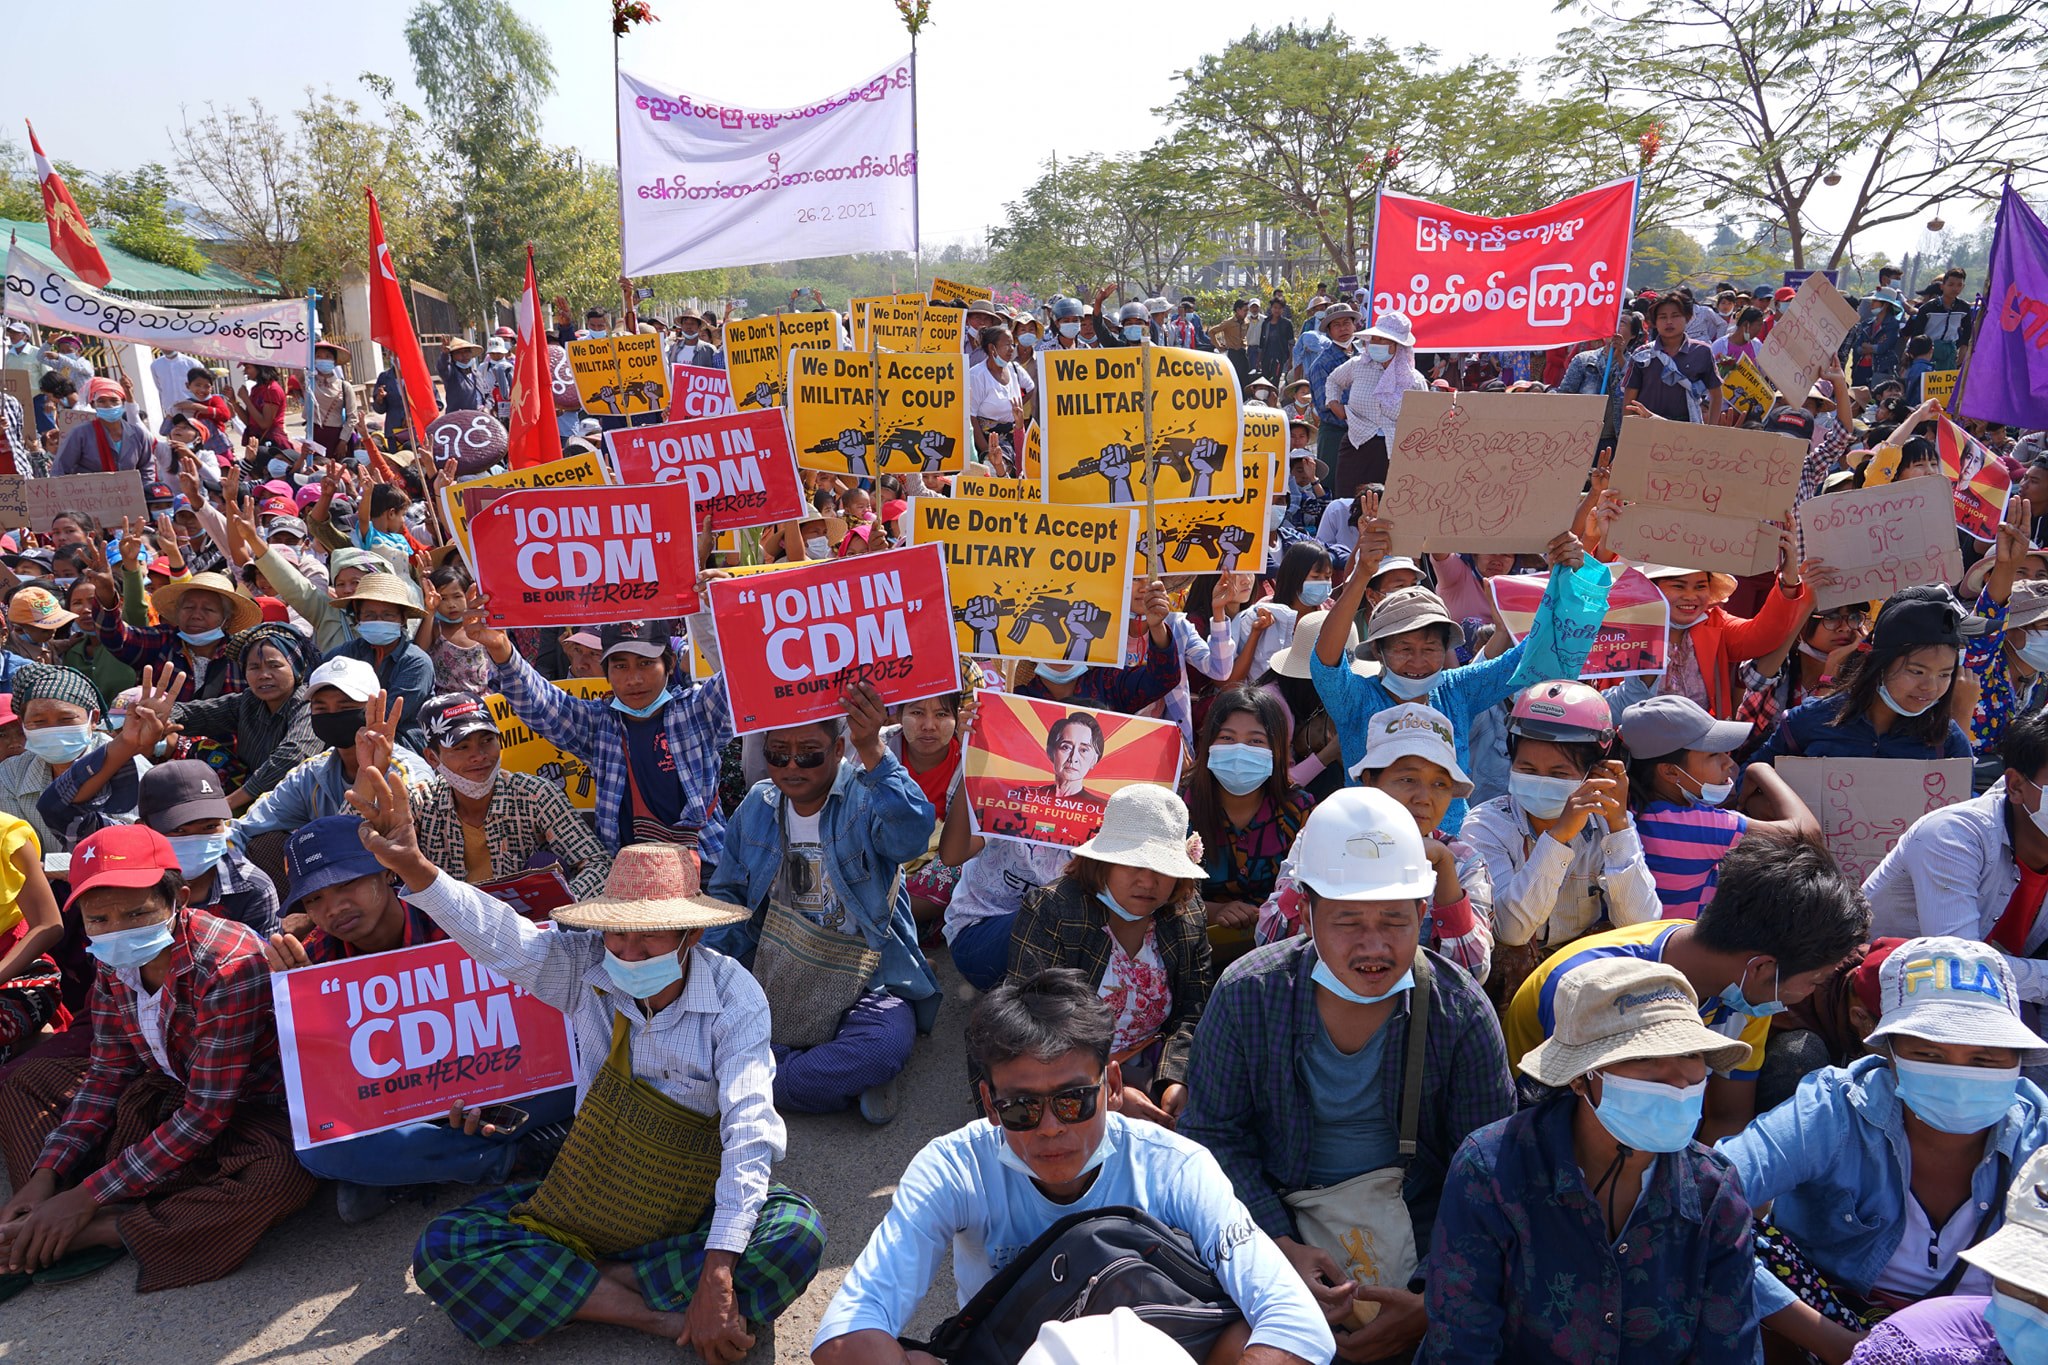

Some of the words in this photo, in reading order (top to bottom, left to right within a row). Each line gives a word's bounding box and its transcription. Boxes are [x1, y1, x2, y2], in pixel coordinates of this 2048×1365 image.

[966, 287, 990, 299] Accept
[874, 307, 890, 319] We
[924, 311, 958, 325] Accept
[730, 327, 747, 342] We
[748, 322, 775, 339] Don't
[779, 318, 829, 336] Accept
[930, 328, 958, 340] COUP
[572, 344, 587, 357] We
[618, 337, 656, 353] Accept
[628, 354, 658, 368] COUP
[802, 357, 828, 376] We
[888, 362, 954, 384] Accept
[1055, 359, 1088, 381] We
[1157, 355, 1223, 381] Accept
[1928, 375, 1942, 383] We
[1928, 386, 1955, 395] MILIT
[801, 385, 890, 406] MILITARY
[902, 389, 955, 408] COUP
[1172, 387, 1228, 410] COUP
[721, 427, 756, 456] IN
[532, 462, 594, 487] Accept
[963, 481, 984, 496] We
[989, 483, 1024, 499] Don't
[705, 491, 767, 517] HEROES
[1966, 497, 1980, 509] OUR
[1968, 508, 1988, 522] HOPE
[611, 503, 652, 535] IN
[926, 508, 960, 531] We
[968, 509, 1028, 534] Don't
[1035, 513, 1117, 544] Accept
[946, 543, 1036, 568] ILITARY
[1050, 548, 1116, 573] COUP
[523, 591, 542, 604] BE
[544, 590, 576, 603] OUR
[579, 580, 660, 607] HEROES
[860, 570, 904, 609] IN
[1600, 633, 1625, 642] OUR
[1610, 641, 1648, 651] HOPE
[774, 684, 794, 699] BE
[797, 679, 830, 695] OUR
[832, 655, 913, 695] HEROES
[201, 779, 213, 793] A
[977, 796, 1038, 815] LEADER
[1044, 808, 1087, 823] FUTURE
[1007, 789, 1052, 807] PLEASE
[1055, 799, 1083, 812] SAVE
[1086, 804, 1108, 816] OU
[460, 958, 510, 995] IN
[1906, 957, 2002, 1000] FILA
[358, 1083, 379, 1101] BE
[384, 1072, 422, 1092] OUR
[426, 1044, 522, 1090] HEROES
